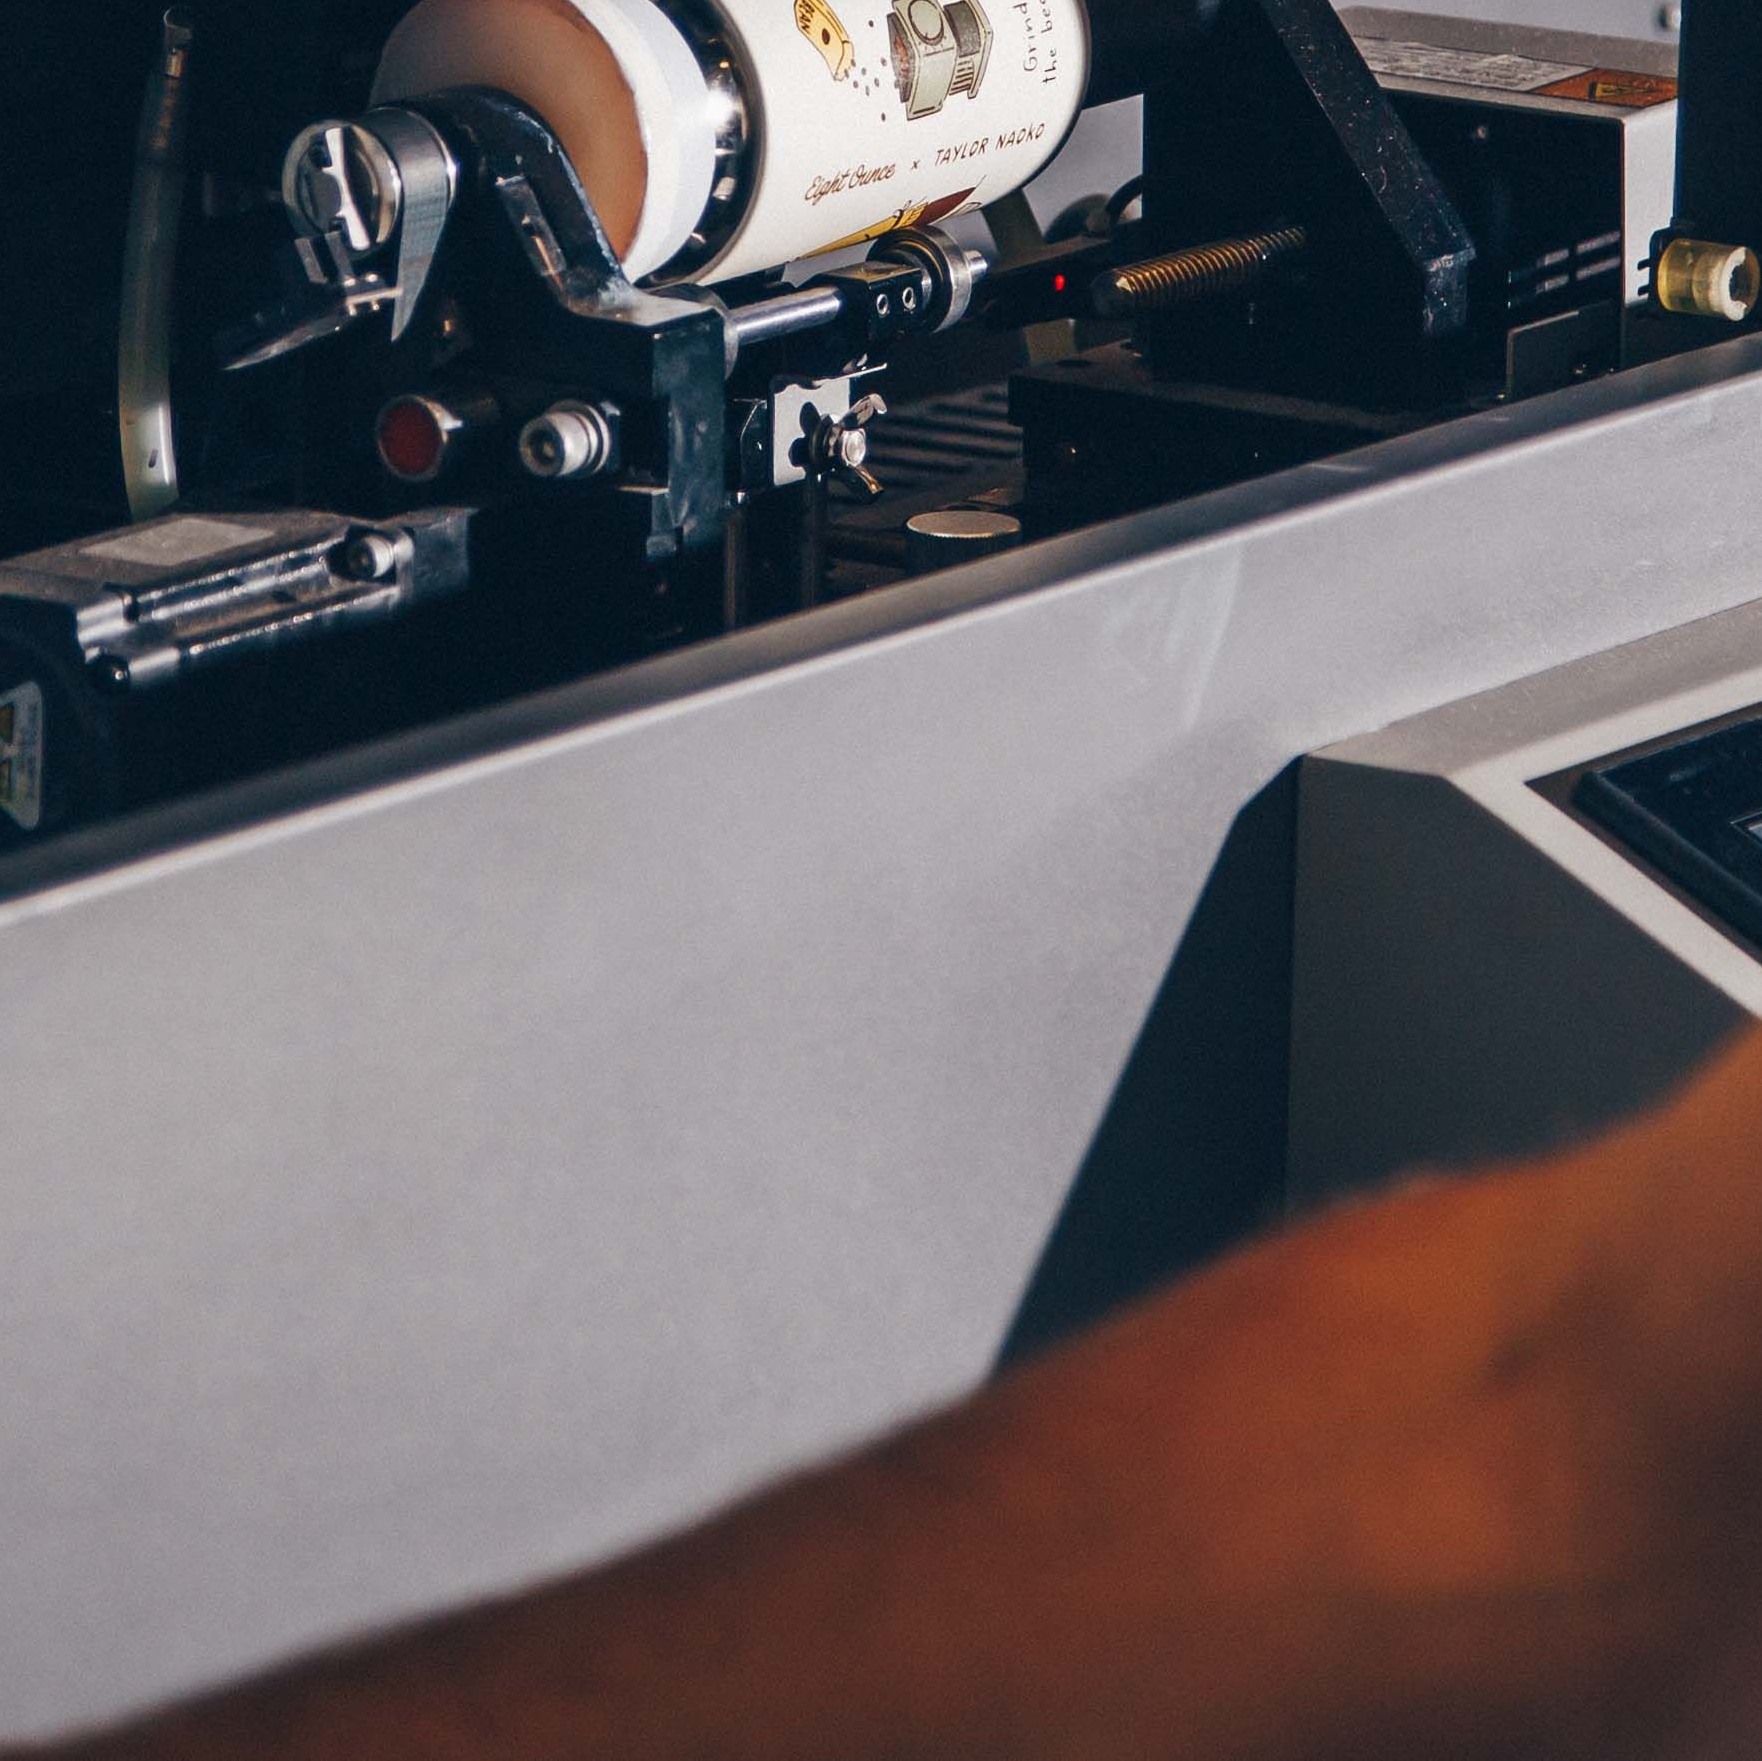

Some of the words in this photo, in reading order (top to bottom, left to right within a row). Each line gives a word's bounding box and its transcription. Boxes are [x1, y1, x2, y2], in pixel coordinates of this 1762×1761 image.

[1013, 3, 1038, 72] Grind
[1043, 48, 1057, 85] the
[935, 137, 990, 167] TAYLOR
[995, 122, 1046, 151] NAOKO
